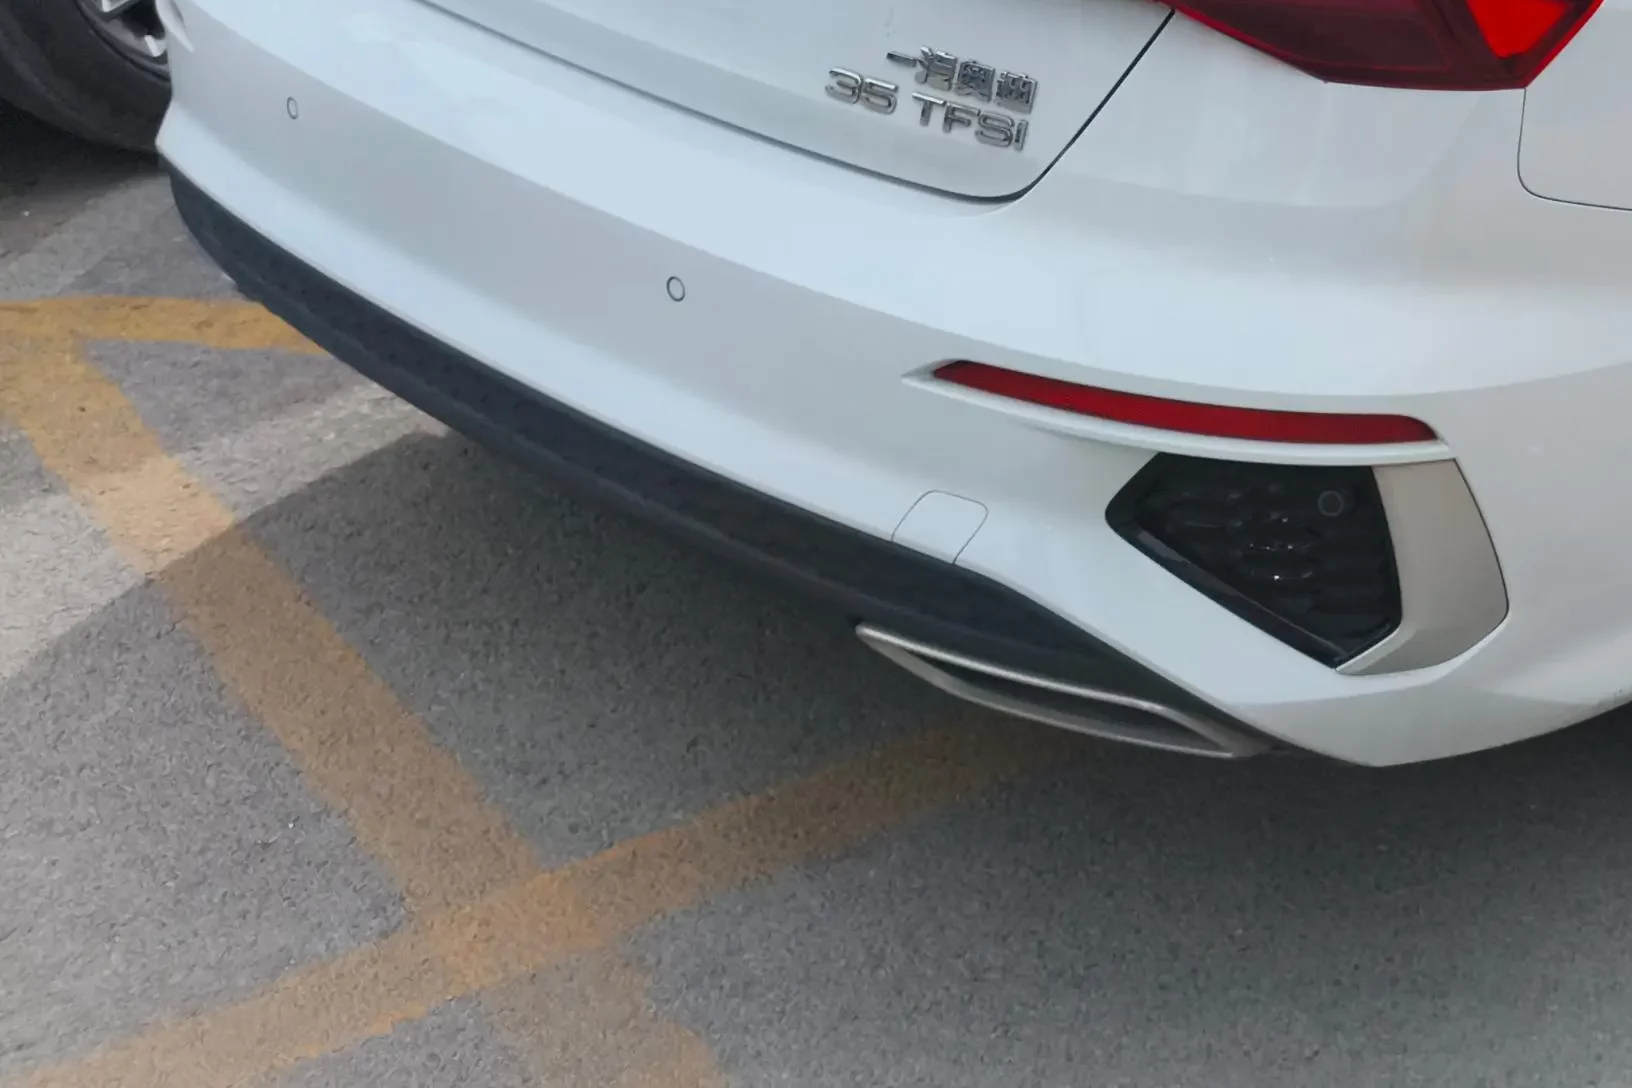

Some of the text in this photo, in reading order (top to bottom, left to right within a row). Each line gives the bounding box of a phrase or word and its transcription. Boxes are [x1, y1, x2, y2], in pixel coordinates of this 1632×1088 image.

[824, 67, 1029, 152] 35 TFSI
[886, 45, 1038, 114] 一汽奥迪
